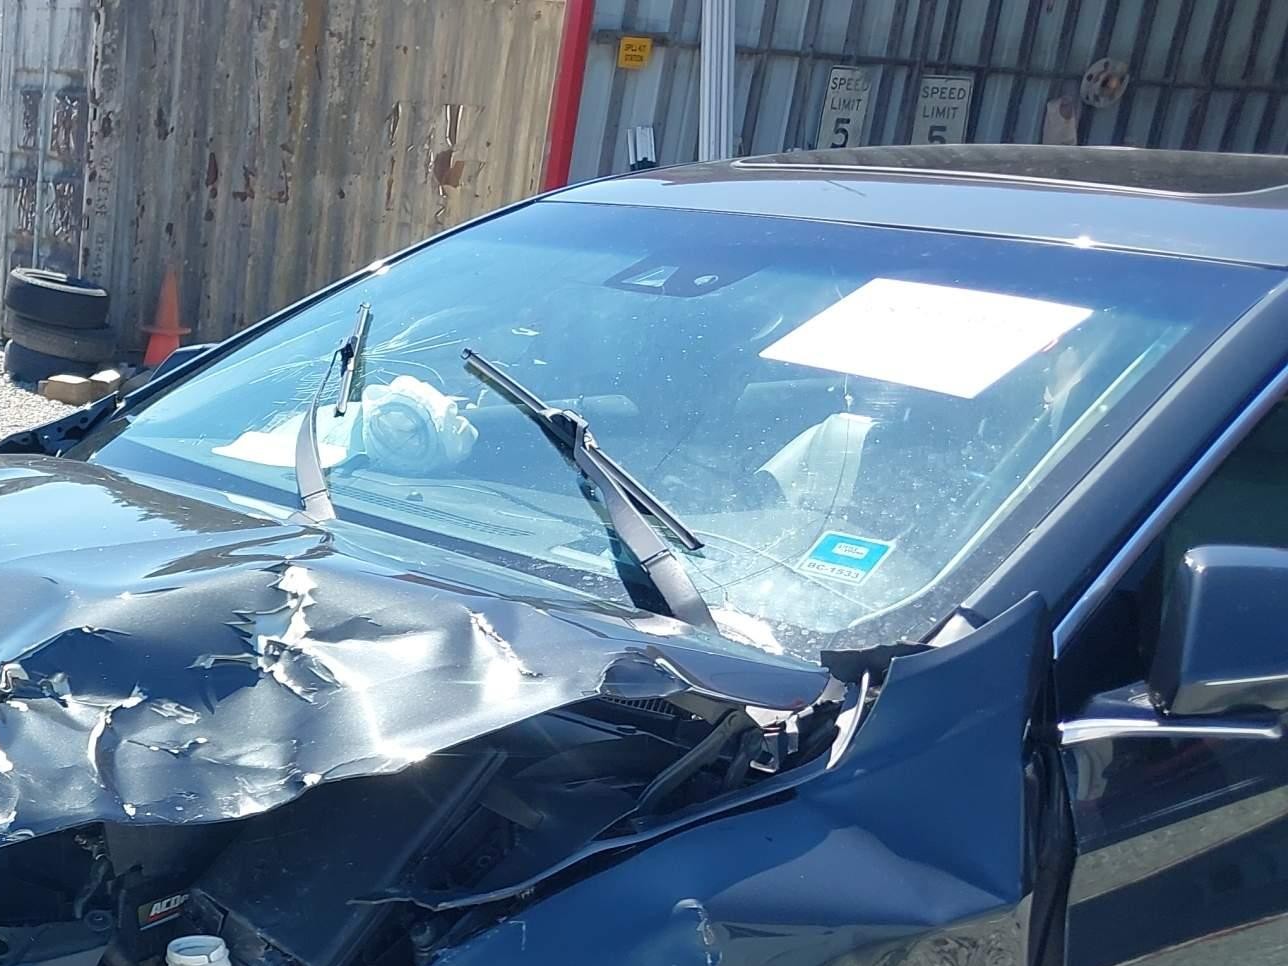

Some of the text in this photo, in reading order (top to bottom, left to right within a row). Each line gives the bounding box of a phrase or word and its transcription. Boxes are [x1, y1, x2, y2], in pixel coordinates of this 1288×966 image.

[831, 77, 871, 91] SPEED
[922, 86, 966, 100] SPEED
[830, 97, 862, 111] LIMIT
[922, 106, 959, 119] LIMIT
[830, 117, 851, 149] 5
